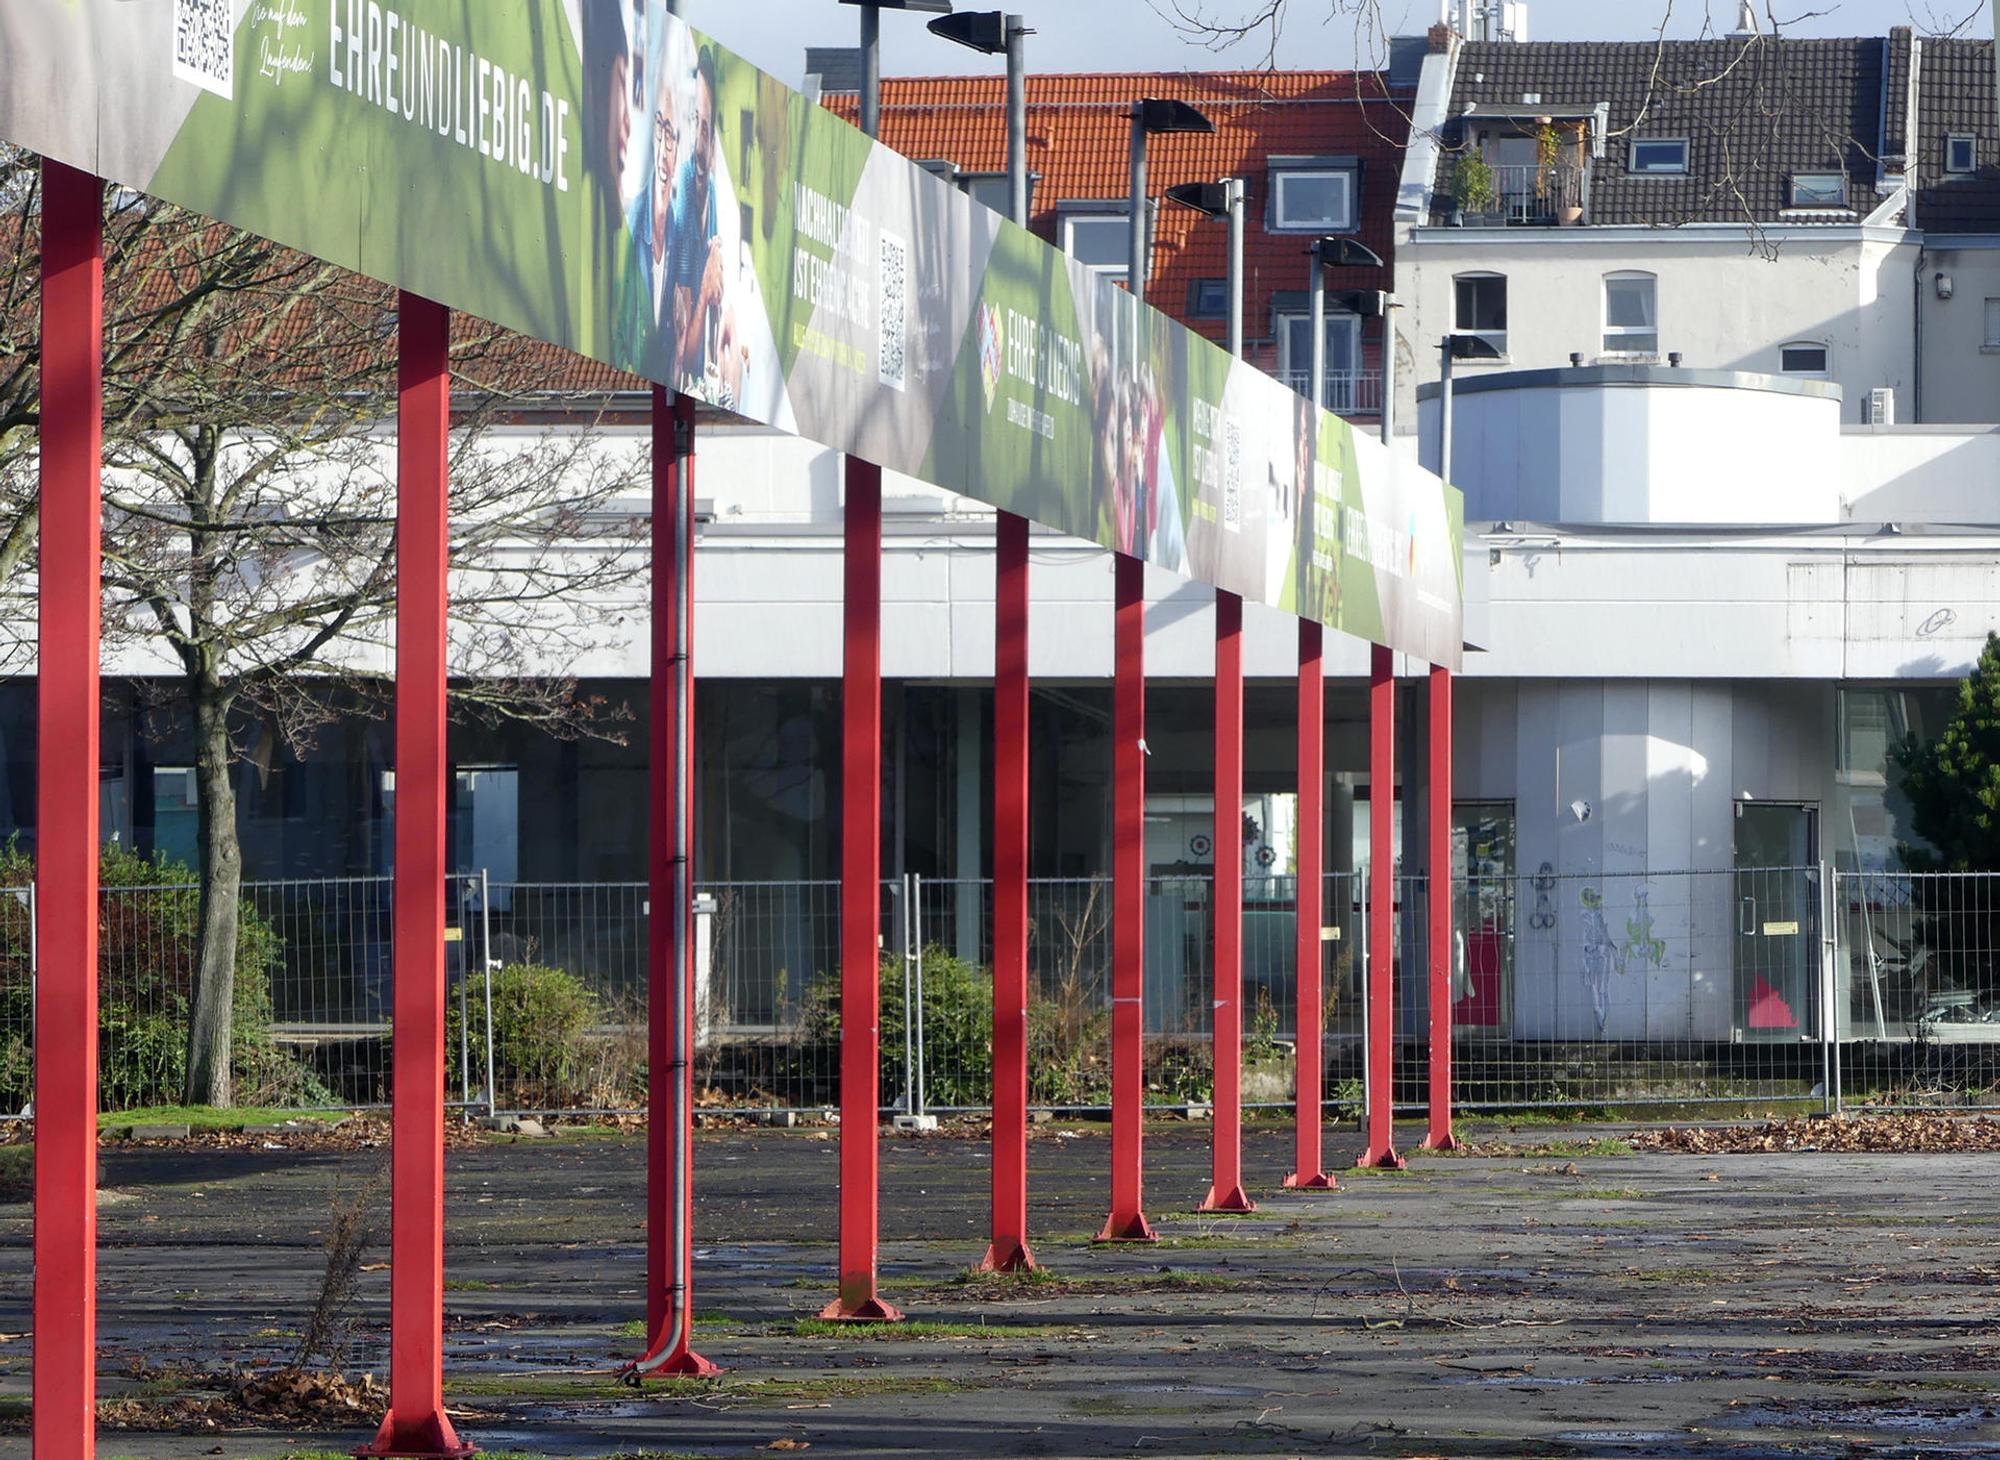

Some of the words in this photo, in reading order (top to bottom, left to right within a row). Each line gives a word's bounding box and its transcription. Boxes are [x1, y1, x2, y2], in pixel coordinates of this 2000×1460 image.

[329, 0, 569, 193] EHREUNDLIEBIG.DE
[793, 246, 809, 301] IST
[1007, 307, 1037, 385] EHRE
[1048, 329, 1081, 406] LIEBIG
